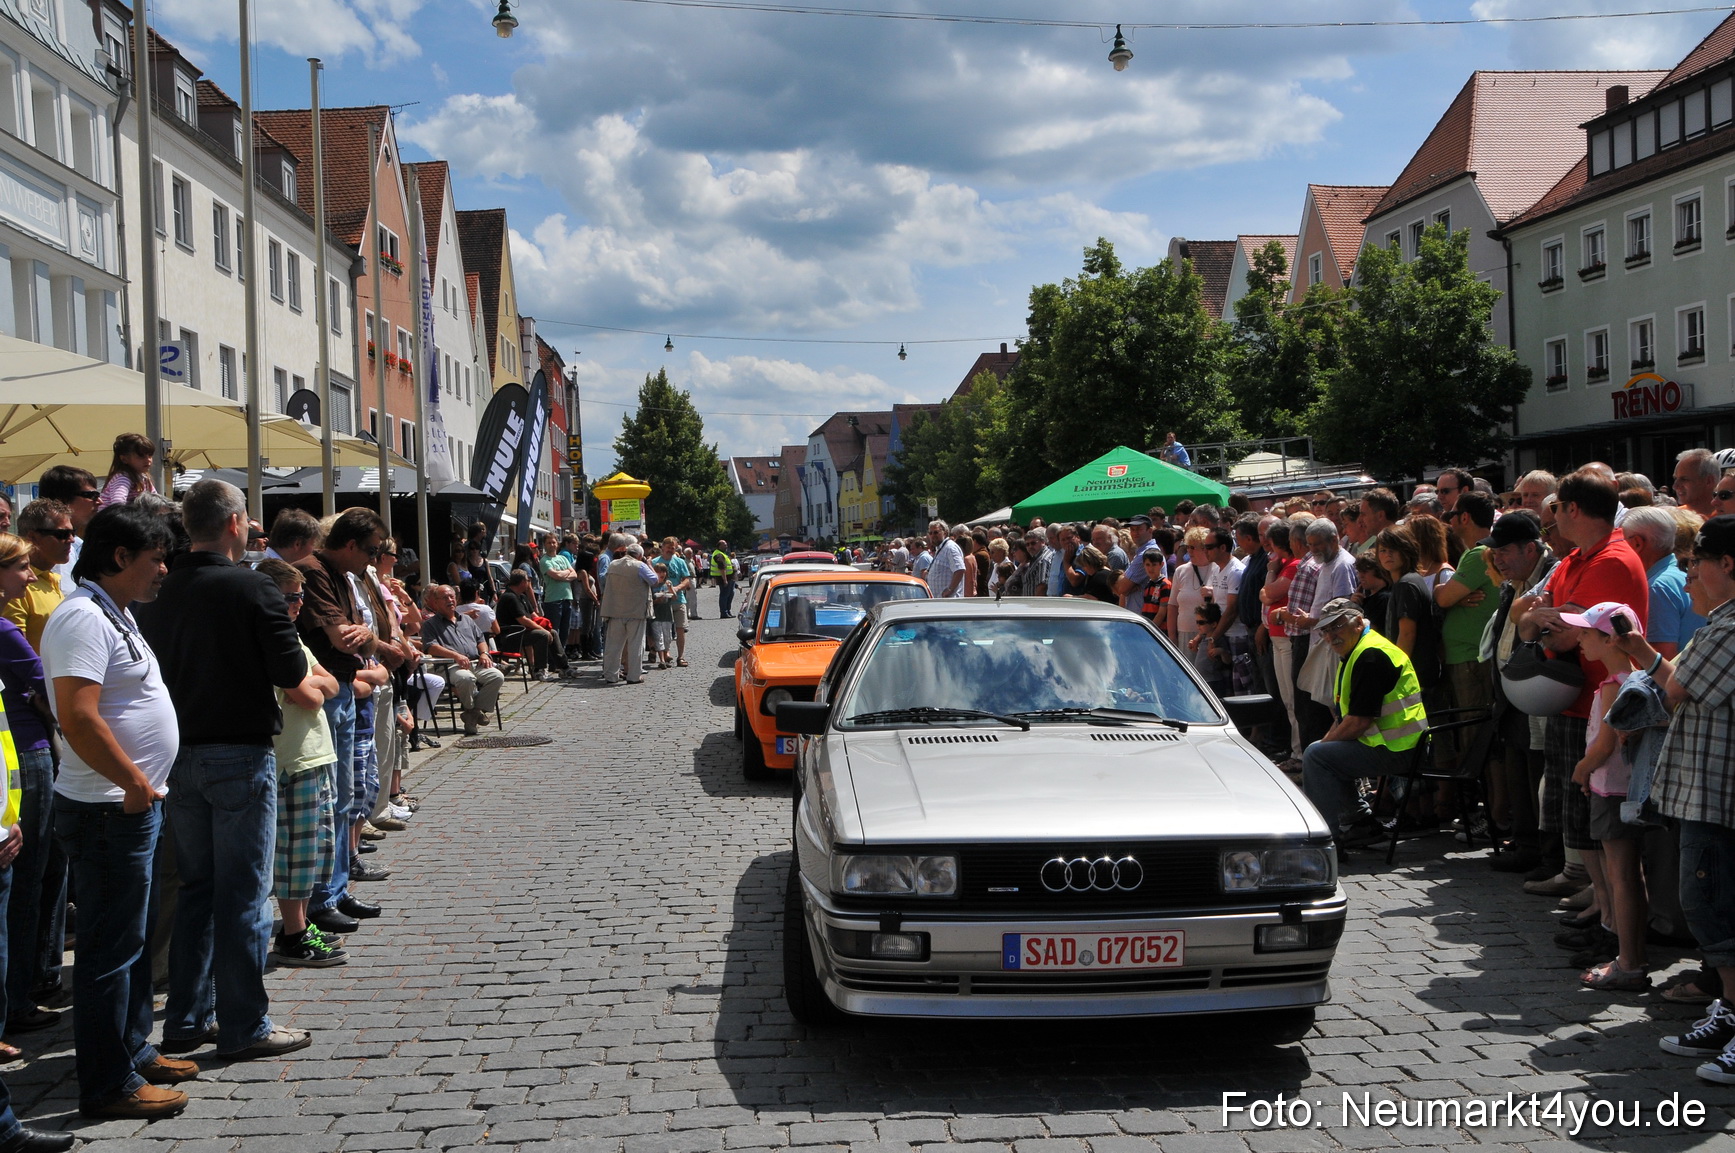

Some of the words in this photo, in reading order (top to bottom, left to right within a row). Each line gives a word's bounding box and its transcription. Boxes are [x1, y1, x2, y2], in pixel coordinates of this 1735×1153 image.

[1611, 381, 1681, 420] RENO
[482, 409, 525, 508] THULE
[522, 398, 545, 507] THULE
[568, 436, 582, 503] HOTEL
[1074, 481, 1155, 493] Lammsbräu
[1087, 476, 1146, 486] Neumarkter
[1008, 955, 1016, 963] D
[1025, 937, 1076, 966] SAD
[1097, 935, 1178, 965] 07052
